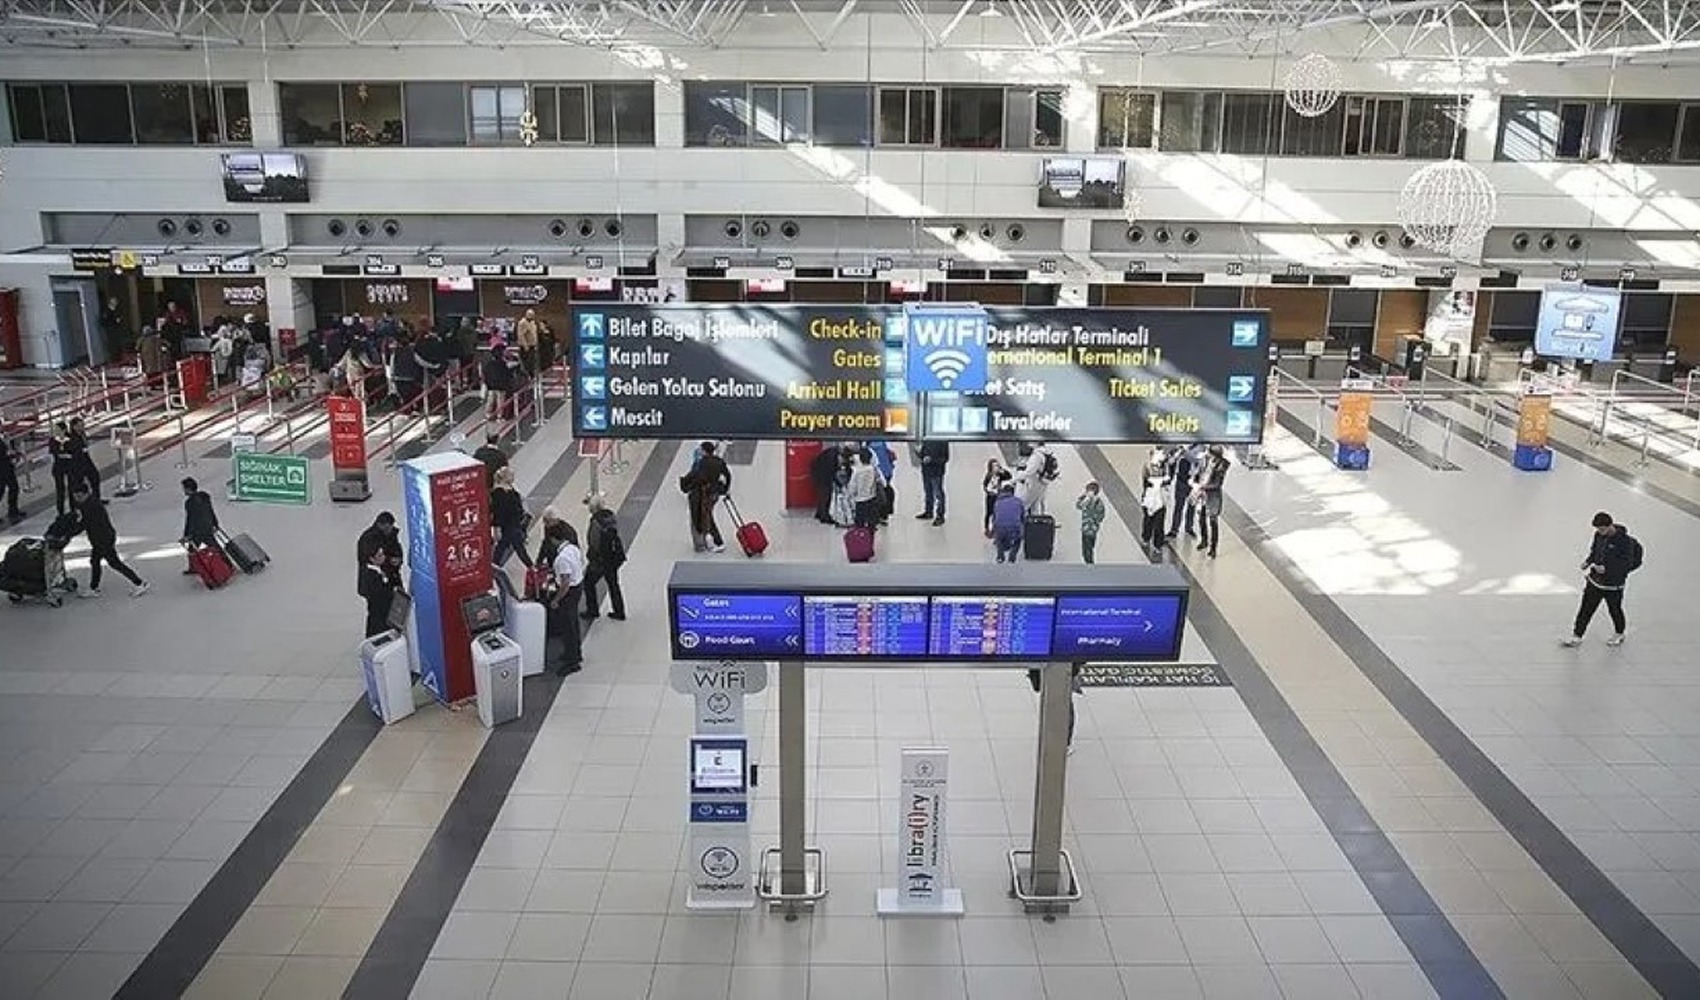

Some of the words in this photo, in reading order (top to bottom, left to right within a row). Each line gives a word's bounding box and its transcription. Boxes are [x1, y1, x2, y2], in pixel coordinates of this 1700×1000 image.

[608, 317, 647, 336] Bilet
[652, 317, 699, 342] Bagaj
[810, 317, 882, 339] Check-in
[913, 317, 985, 346] WiFi
[987, 324, 1011, 348] Dış
[1016, 325, 1068, 345] Hatlar
[1072, 326, 1149, 345] Terminali
[610, 345, 670, 369] Kapılar
[833, 348, 882, 367] Gates
[1077, 347, 1147, 366] Terminal
[1153, 347, 1161, 366] 1
[610, 376, 658, 396] Gelen
[662, 377, 704, 396] Yolcu
[708, 377, 766, 398] Salonu
[787, 380, 841, 399] Arrival
[847, 380, 881, 399] Hall
[1005, 377, 1046, 402] Satış
[1109, 378, 1156, 397] Ticket
[1159, 378, 1202, 397] Sales
[611, 406, 663, 426] Mescit
[781, 409, 834, 432] Prayer
[838, 414, 881, 428] room
[992, 410, 1073, 431] Tuvaletler
[1148, 412, 1200, 432] Toilets
[239, 474, 287, 486] SHELTER
[444, 511, 453, 524] 1
[447, 545, 457, 560] 2
[693, 671, 745, 689] WiFi
[906, 794, 930, 867] libra(i)ry
